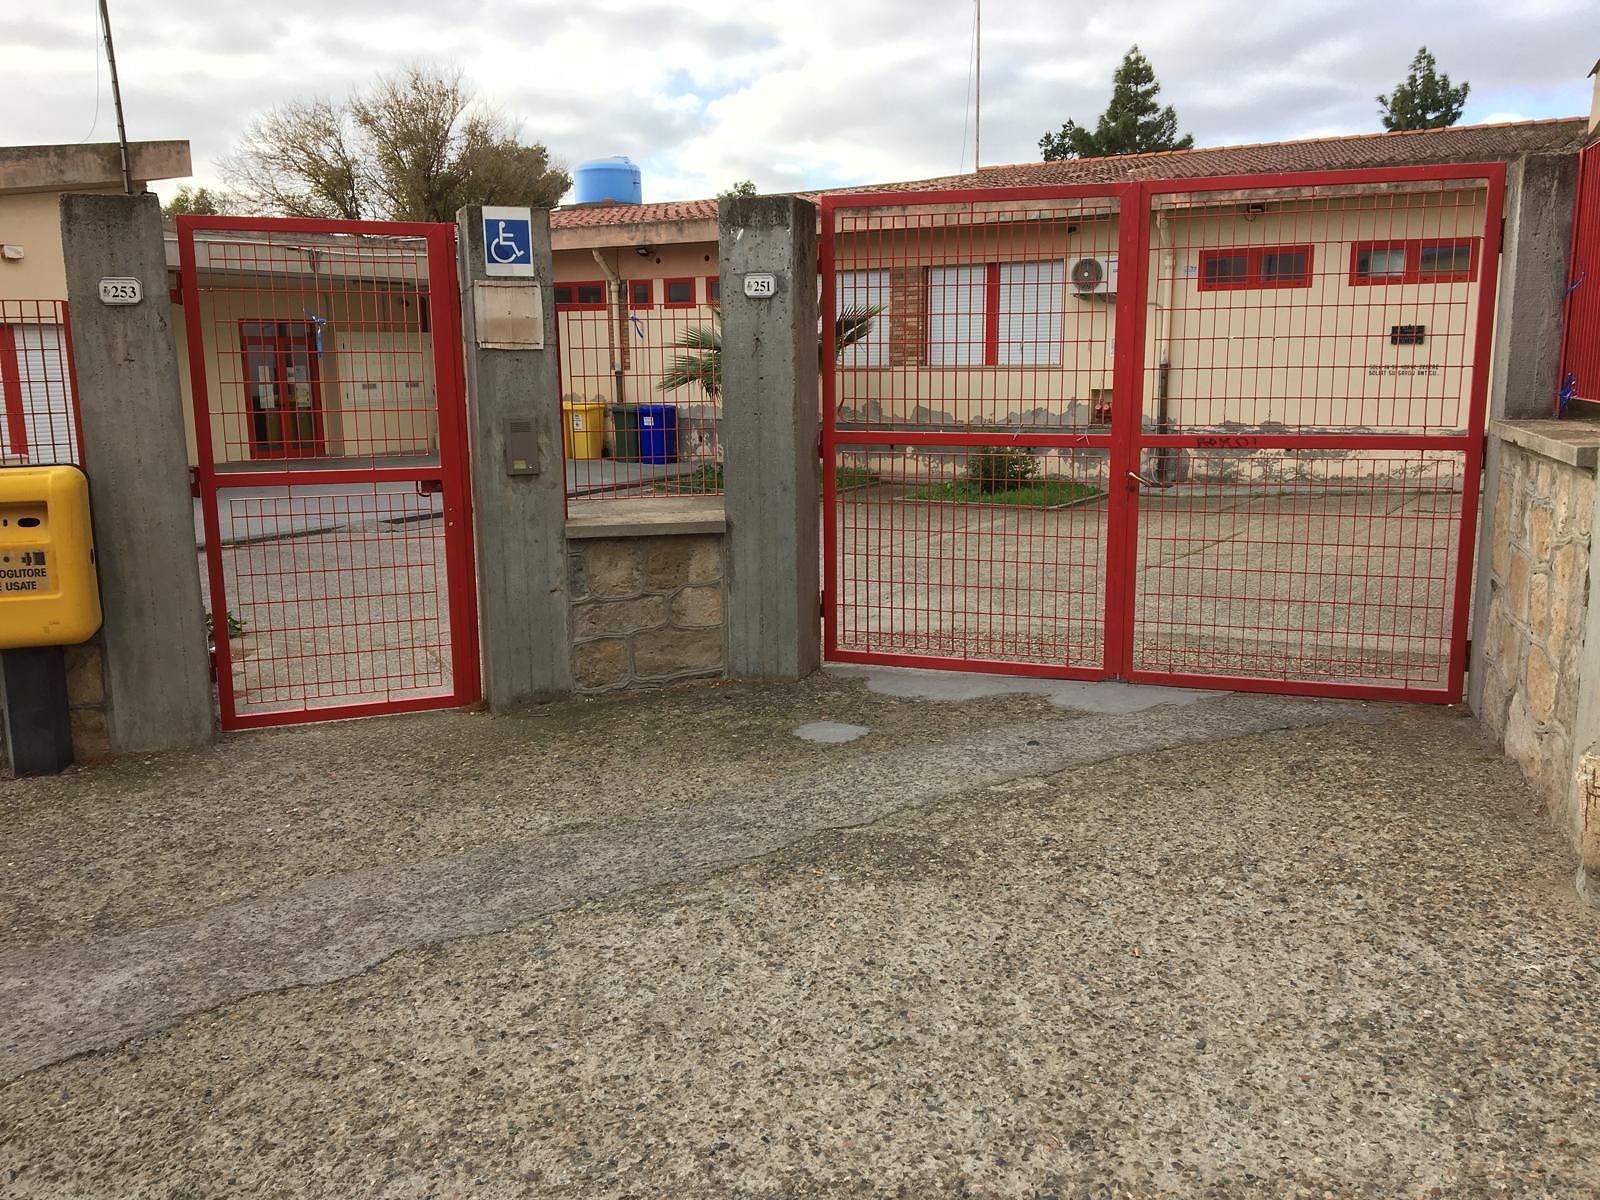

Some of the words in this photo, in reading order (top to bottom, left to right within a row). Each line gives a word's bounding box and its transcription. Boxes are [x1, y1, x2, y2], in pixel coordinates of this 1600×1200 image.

[753, 280, 770, 292] 251
[110, 285, 137, 299] 253
[0, 568, 47, 578] OGLITORE
[5, 581, 37, 591] USATE
